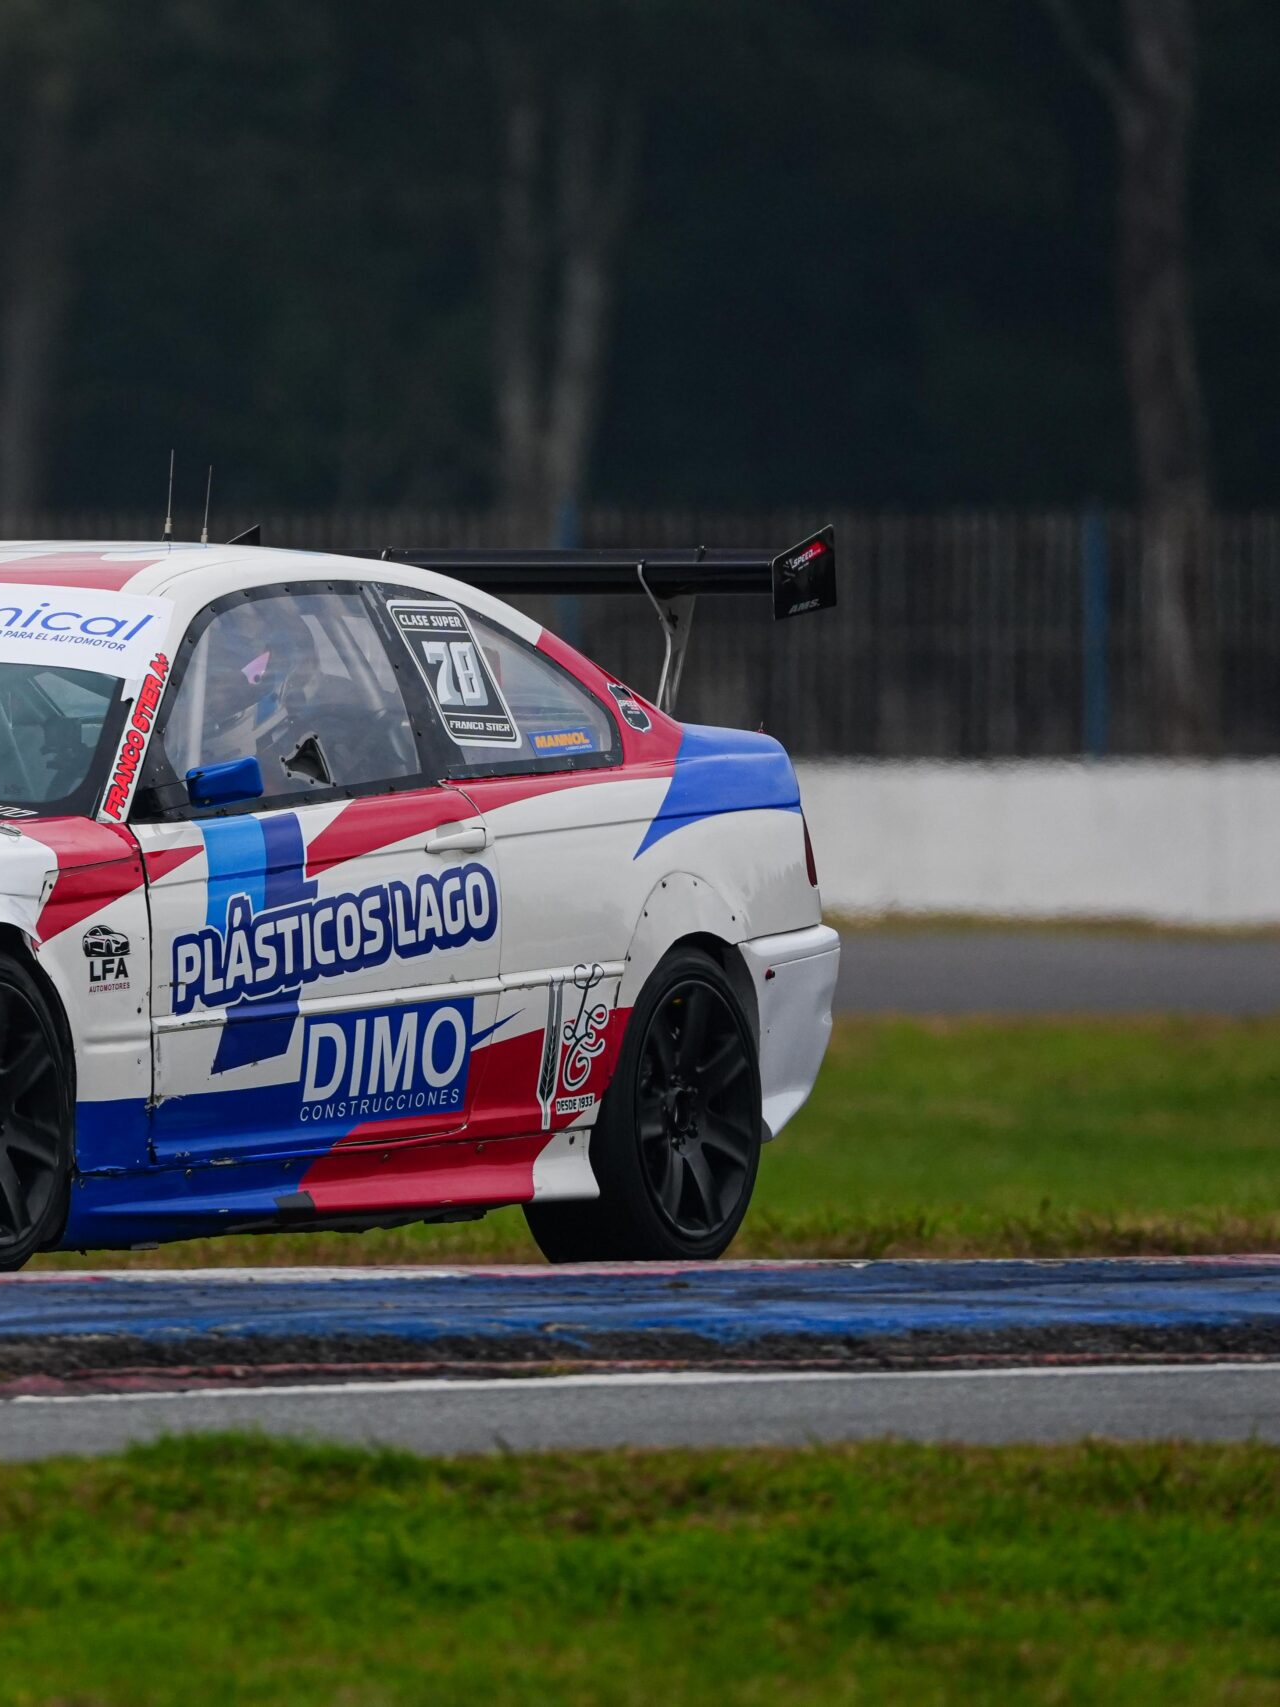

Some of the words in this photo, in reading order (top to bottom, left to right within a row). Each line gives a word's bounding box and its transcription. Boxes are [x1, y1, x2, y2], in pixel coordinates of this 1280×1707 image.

[399, 614, 429, 627] CLASE
[432, 615, 463, 628] SUPER
[4, 630, 34, 640] PARA
[35, 632, 49, 641] EL
[50, 634, 127, 652] AUTOMOTOR
[421, 641, 488, 707] 78
[449, 720, 485, 731] FRANCO
[486, 722, 511, 732] STIER
[103, 729, 145, 820] FRANCO
[132, 673, 164, 733] STIER
[534, 731, 590, 749] MANNOL
[176, 896, 385, 1003] PLÁSTICOS
[393, 869, 494, 944] LAGO
[90, 957, 129, 982] LFA
[89, 982, 131, 993] AUTOMOTORES
[302, 1006, 468, 1104] DIMO
[300, 1088, 460, 1122] CONSTRUCCIONES
[556, 1098, 578, 1112] DESDE
[579, 1095, 594, 1109] 1933
